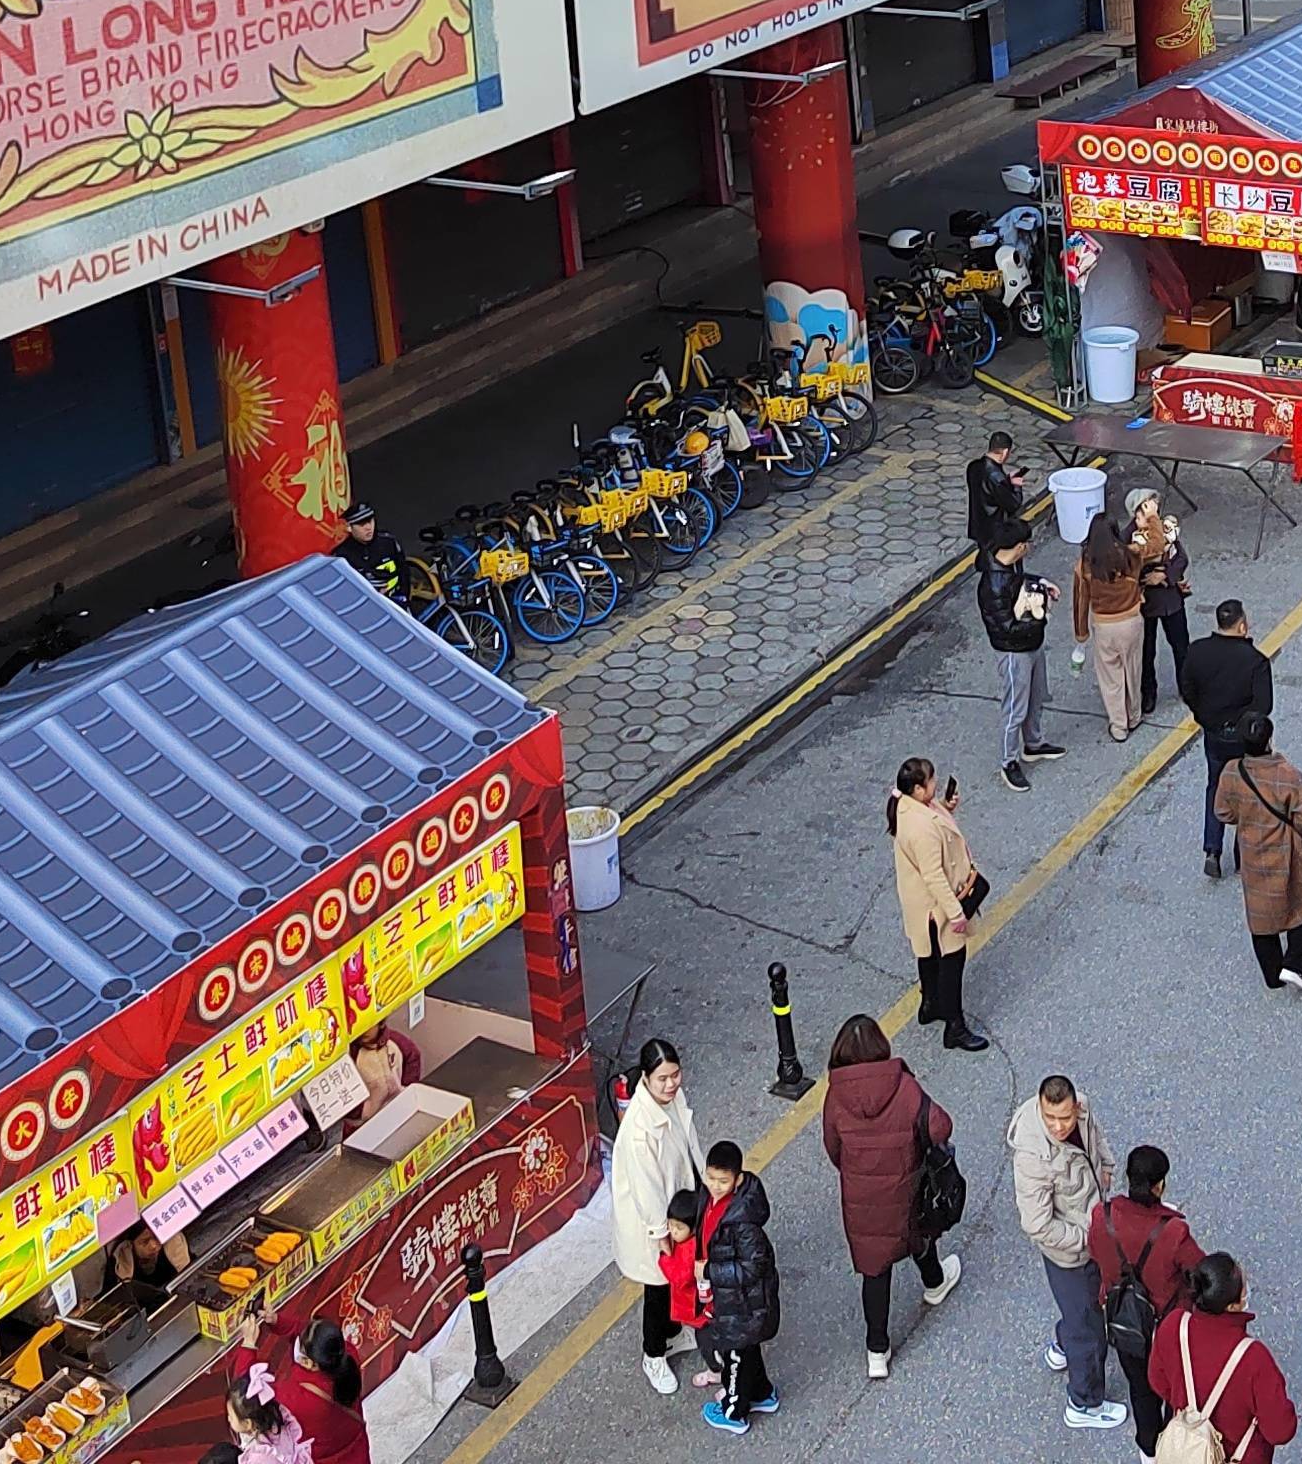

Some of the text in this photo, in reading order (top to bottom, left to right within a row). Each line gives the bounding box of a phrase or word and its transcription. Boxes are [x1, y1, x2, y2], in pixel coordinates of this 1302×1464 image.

[80, 42, 184, 99] BRAND
[688, 42, 715, 66] DO
[725, 24, 762, 51] NOT
[772, 2, 819, 33] HOLD
[22, 62, 241, 151] HONG KONG
[1076, 171, 1182, 202] 泡菜豆腐
[36, 196, 272, 303] MADE IN CHINA
[382, 837, 511, 949] 芝士鲜虾棒
[180, 970, 329, 1105] 芝士鲜虾棒
[307, 1061, 356, 1101] 今日特价
